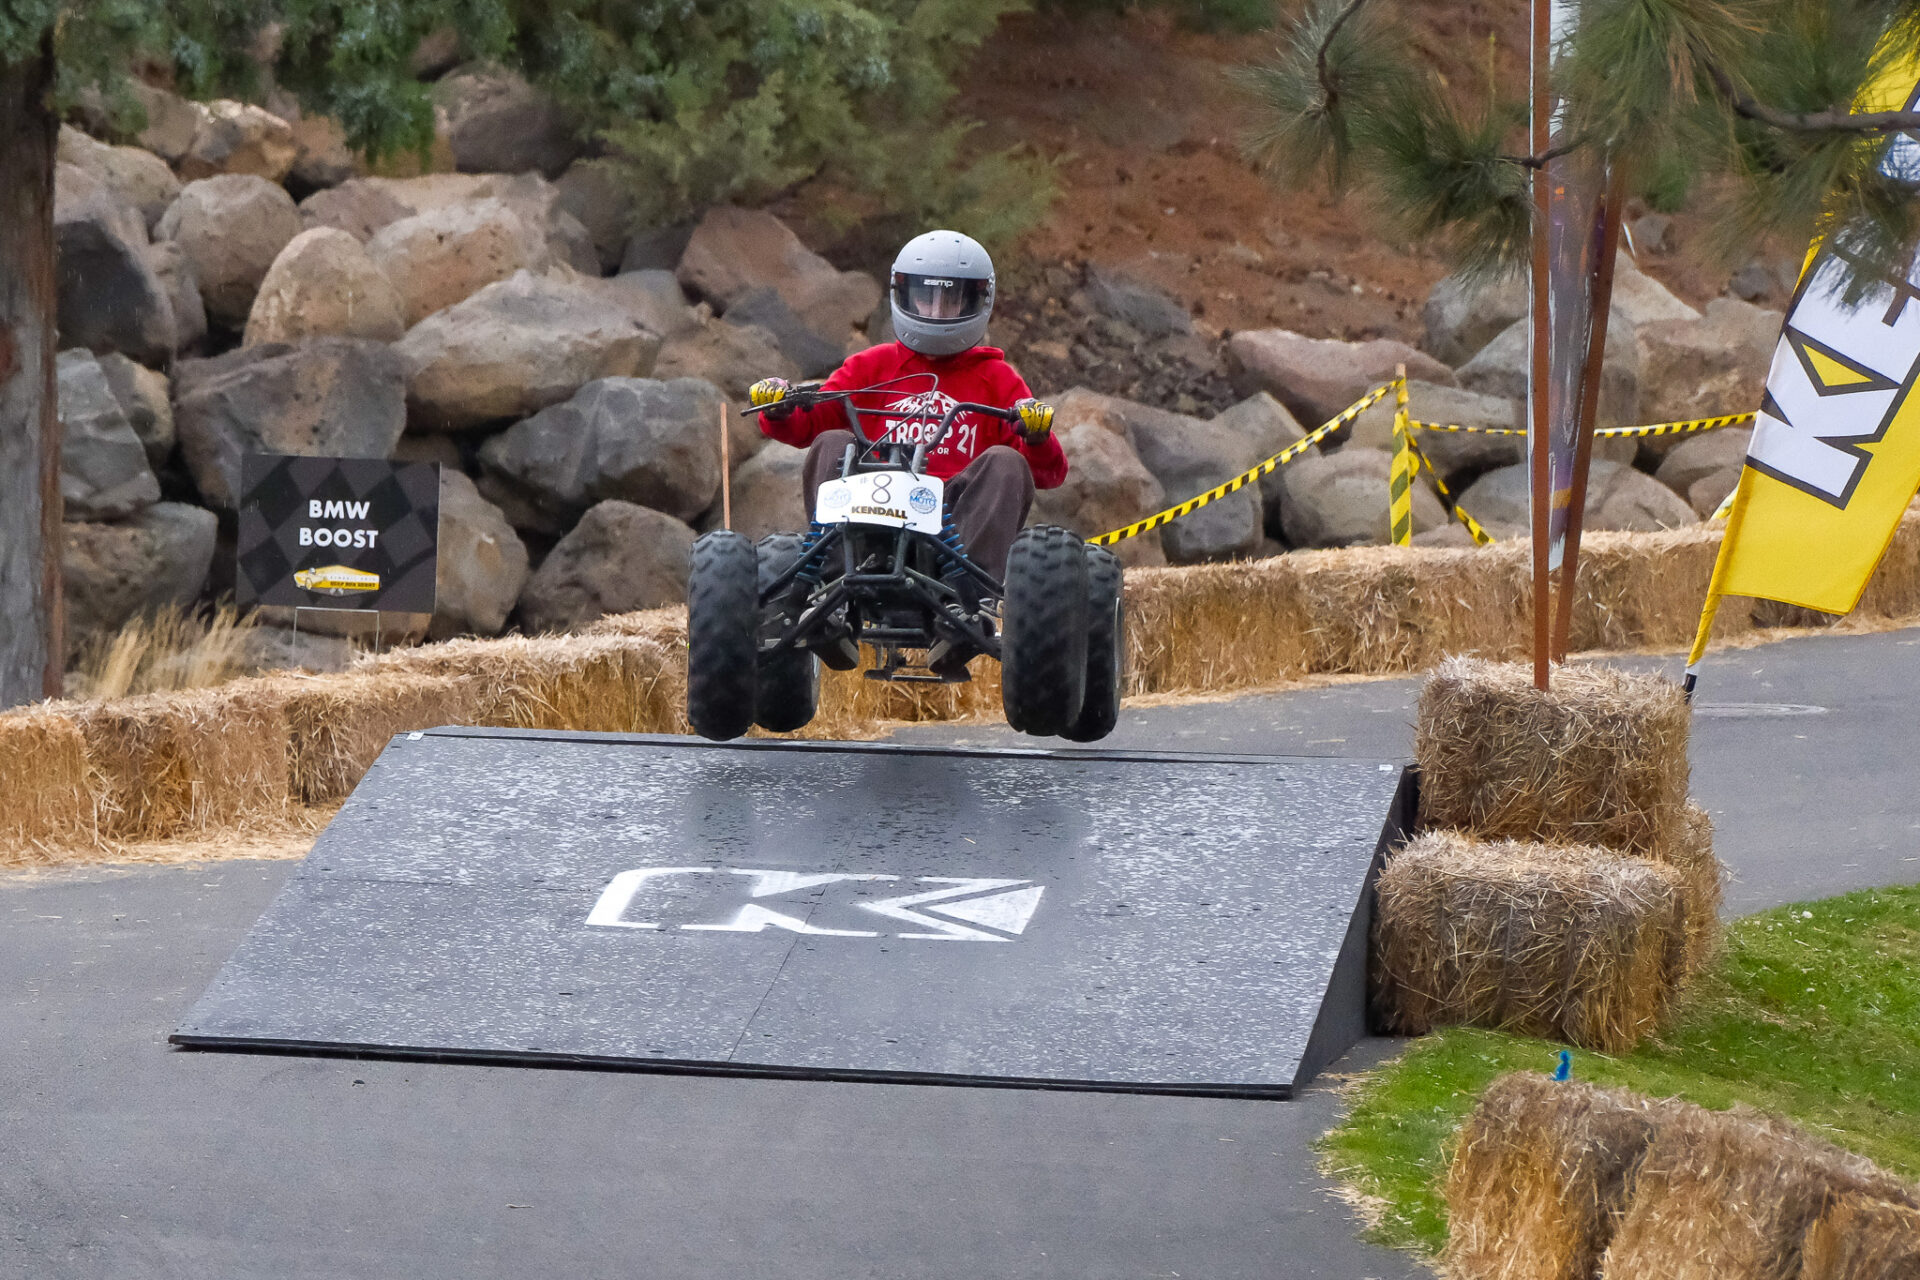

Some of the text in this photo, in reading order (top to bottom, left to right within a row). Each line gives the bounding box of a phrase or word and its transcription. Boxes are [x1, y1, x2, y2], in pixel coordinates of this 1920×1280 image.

[923, 278, 954, 288] zamp
[937, 446, 950, 455] OR
[956, 423, 978, 459] 21
[871, 473, 893, 505] 8
[309, 499, 371, 520] BMW
[851, 505, 909, 520] KENDALL
[299, 527, 379, 549] BOOST
